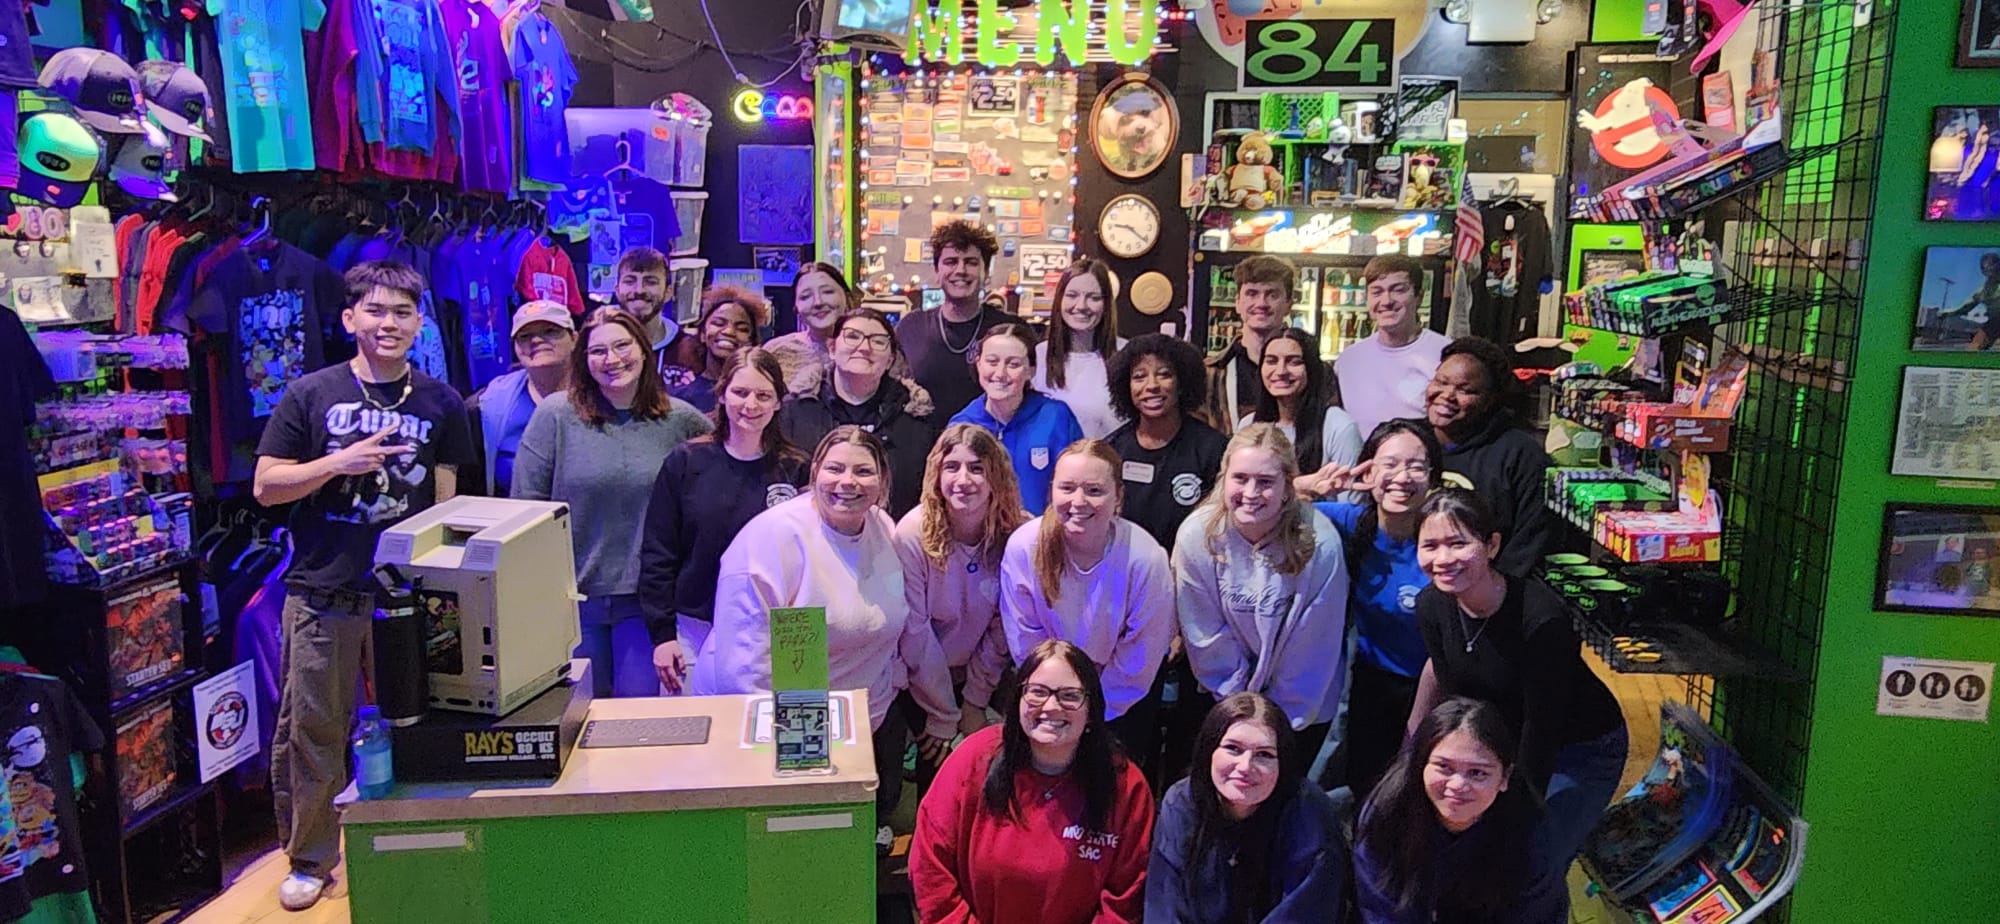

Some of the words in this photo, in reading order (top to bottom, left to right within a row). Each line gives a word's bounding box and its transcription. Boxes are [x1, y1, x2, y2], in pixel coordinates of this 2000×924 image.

[902, 0, 1159, 65] MENU
[1247, 21, 1386, 83] 84
[465, 730, 515, 755] RAY'S
[515, 731, 556, 743] OCCULT
[1078, 844, 1102, 861] SAC
